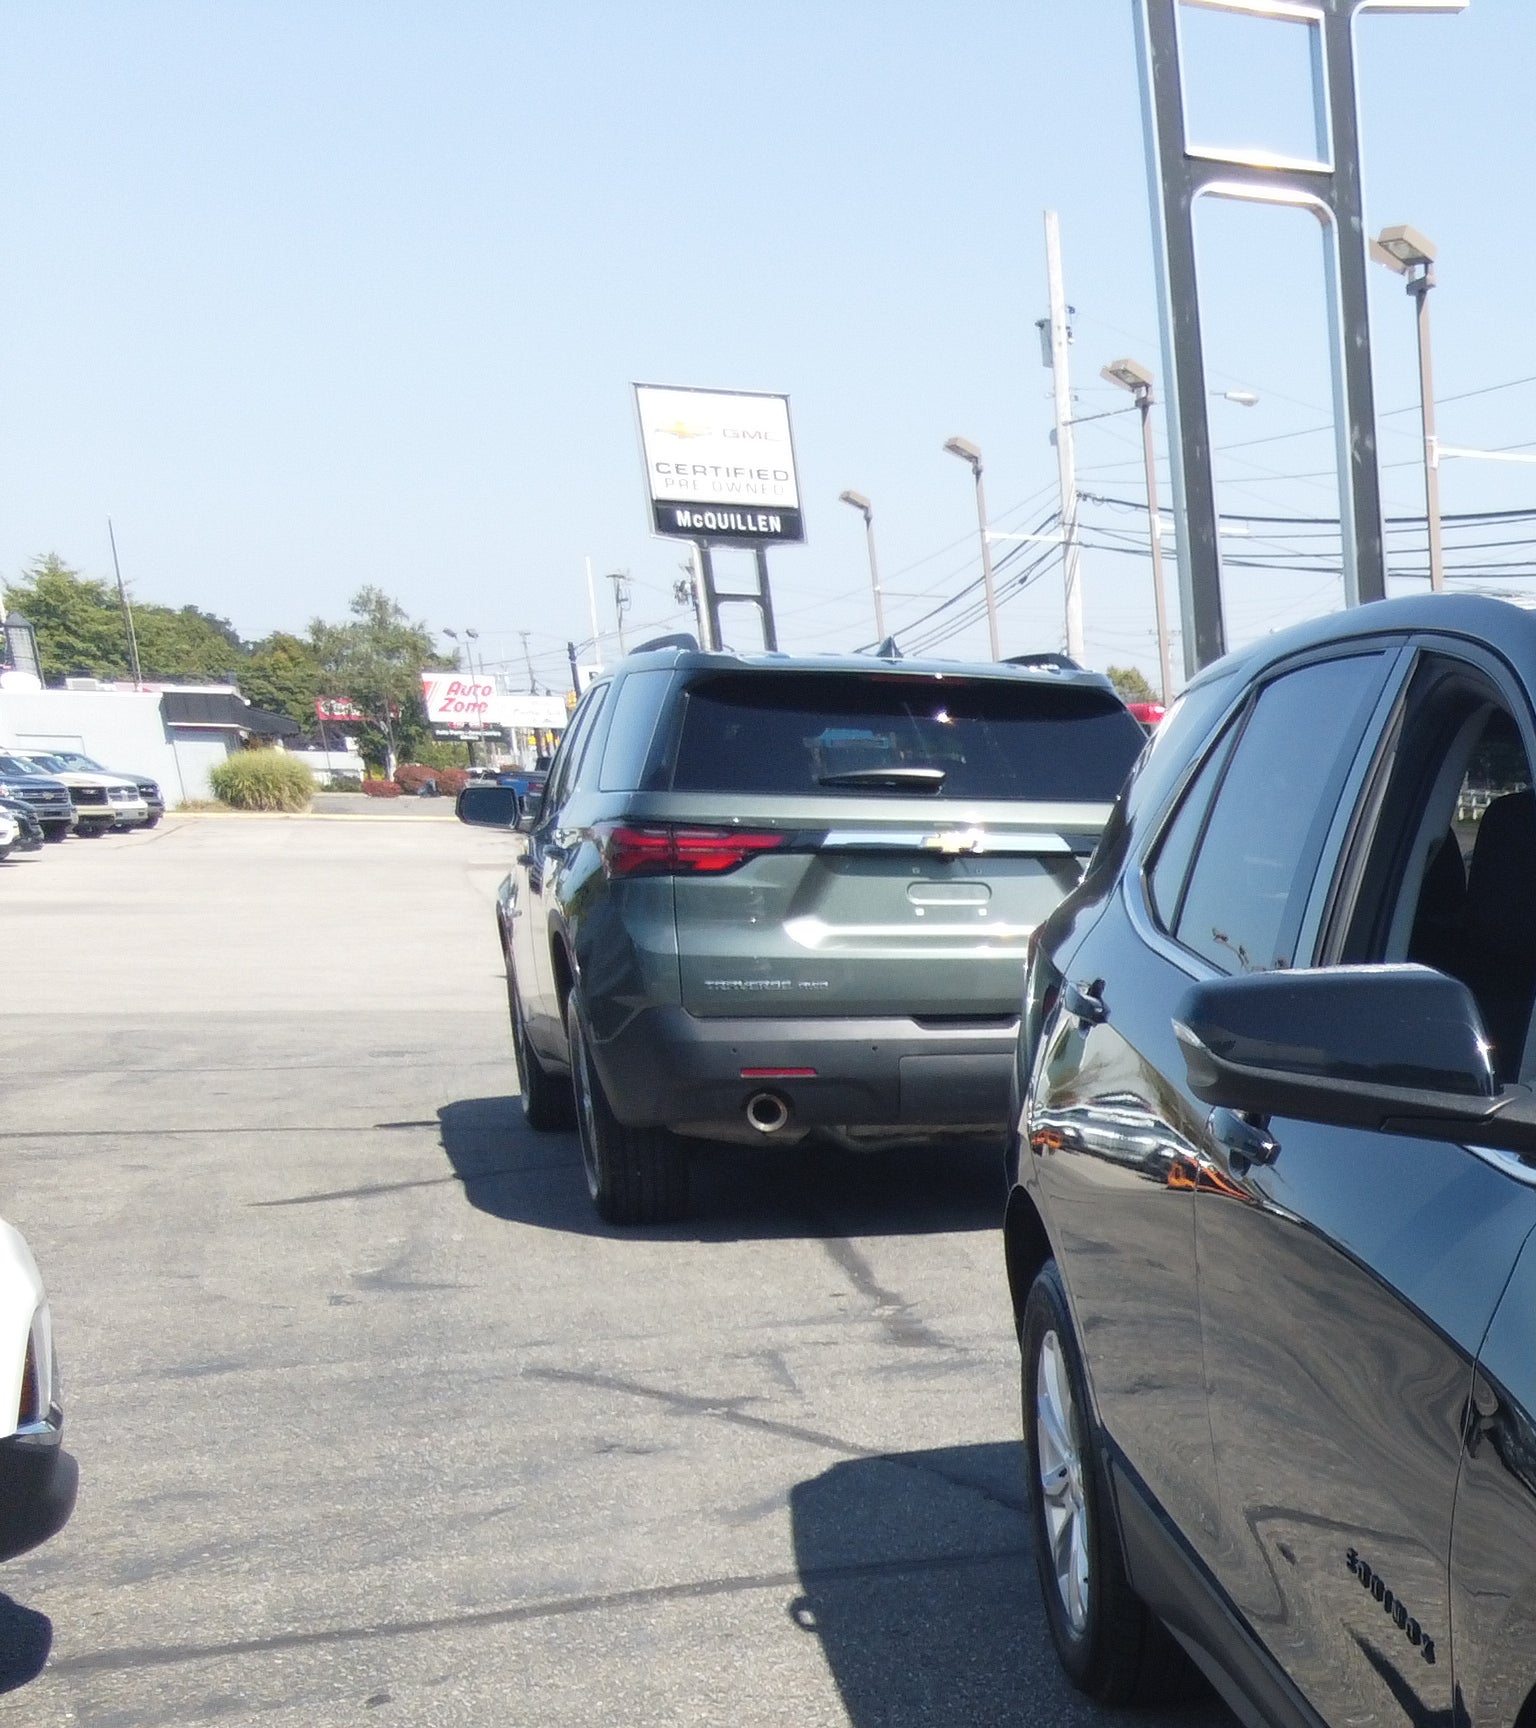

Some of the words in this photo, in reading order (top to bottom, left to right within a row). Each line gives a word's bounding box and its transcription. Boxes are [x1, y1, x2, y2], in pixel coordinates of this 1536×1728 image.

[655, 462, 790, 482] CERTIFIED
[675, 510, 782, 533] McQUILLEN
[446, 680, 493, 697] Auto
[438, 697, 489, 714] Zone
